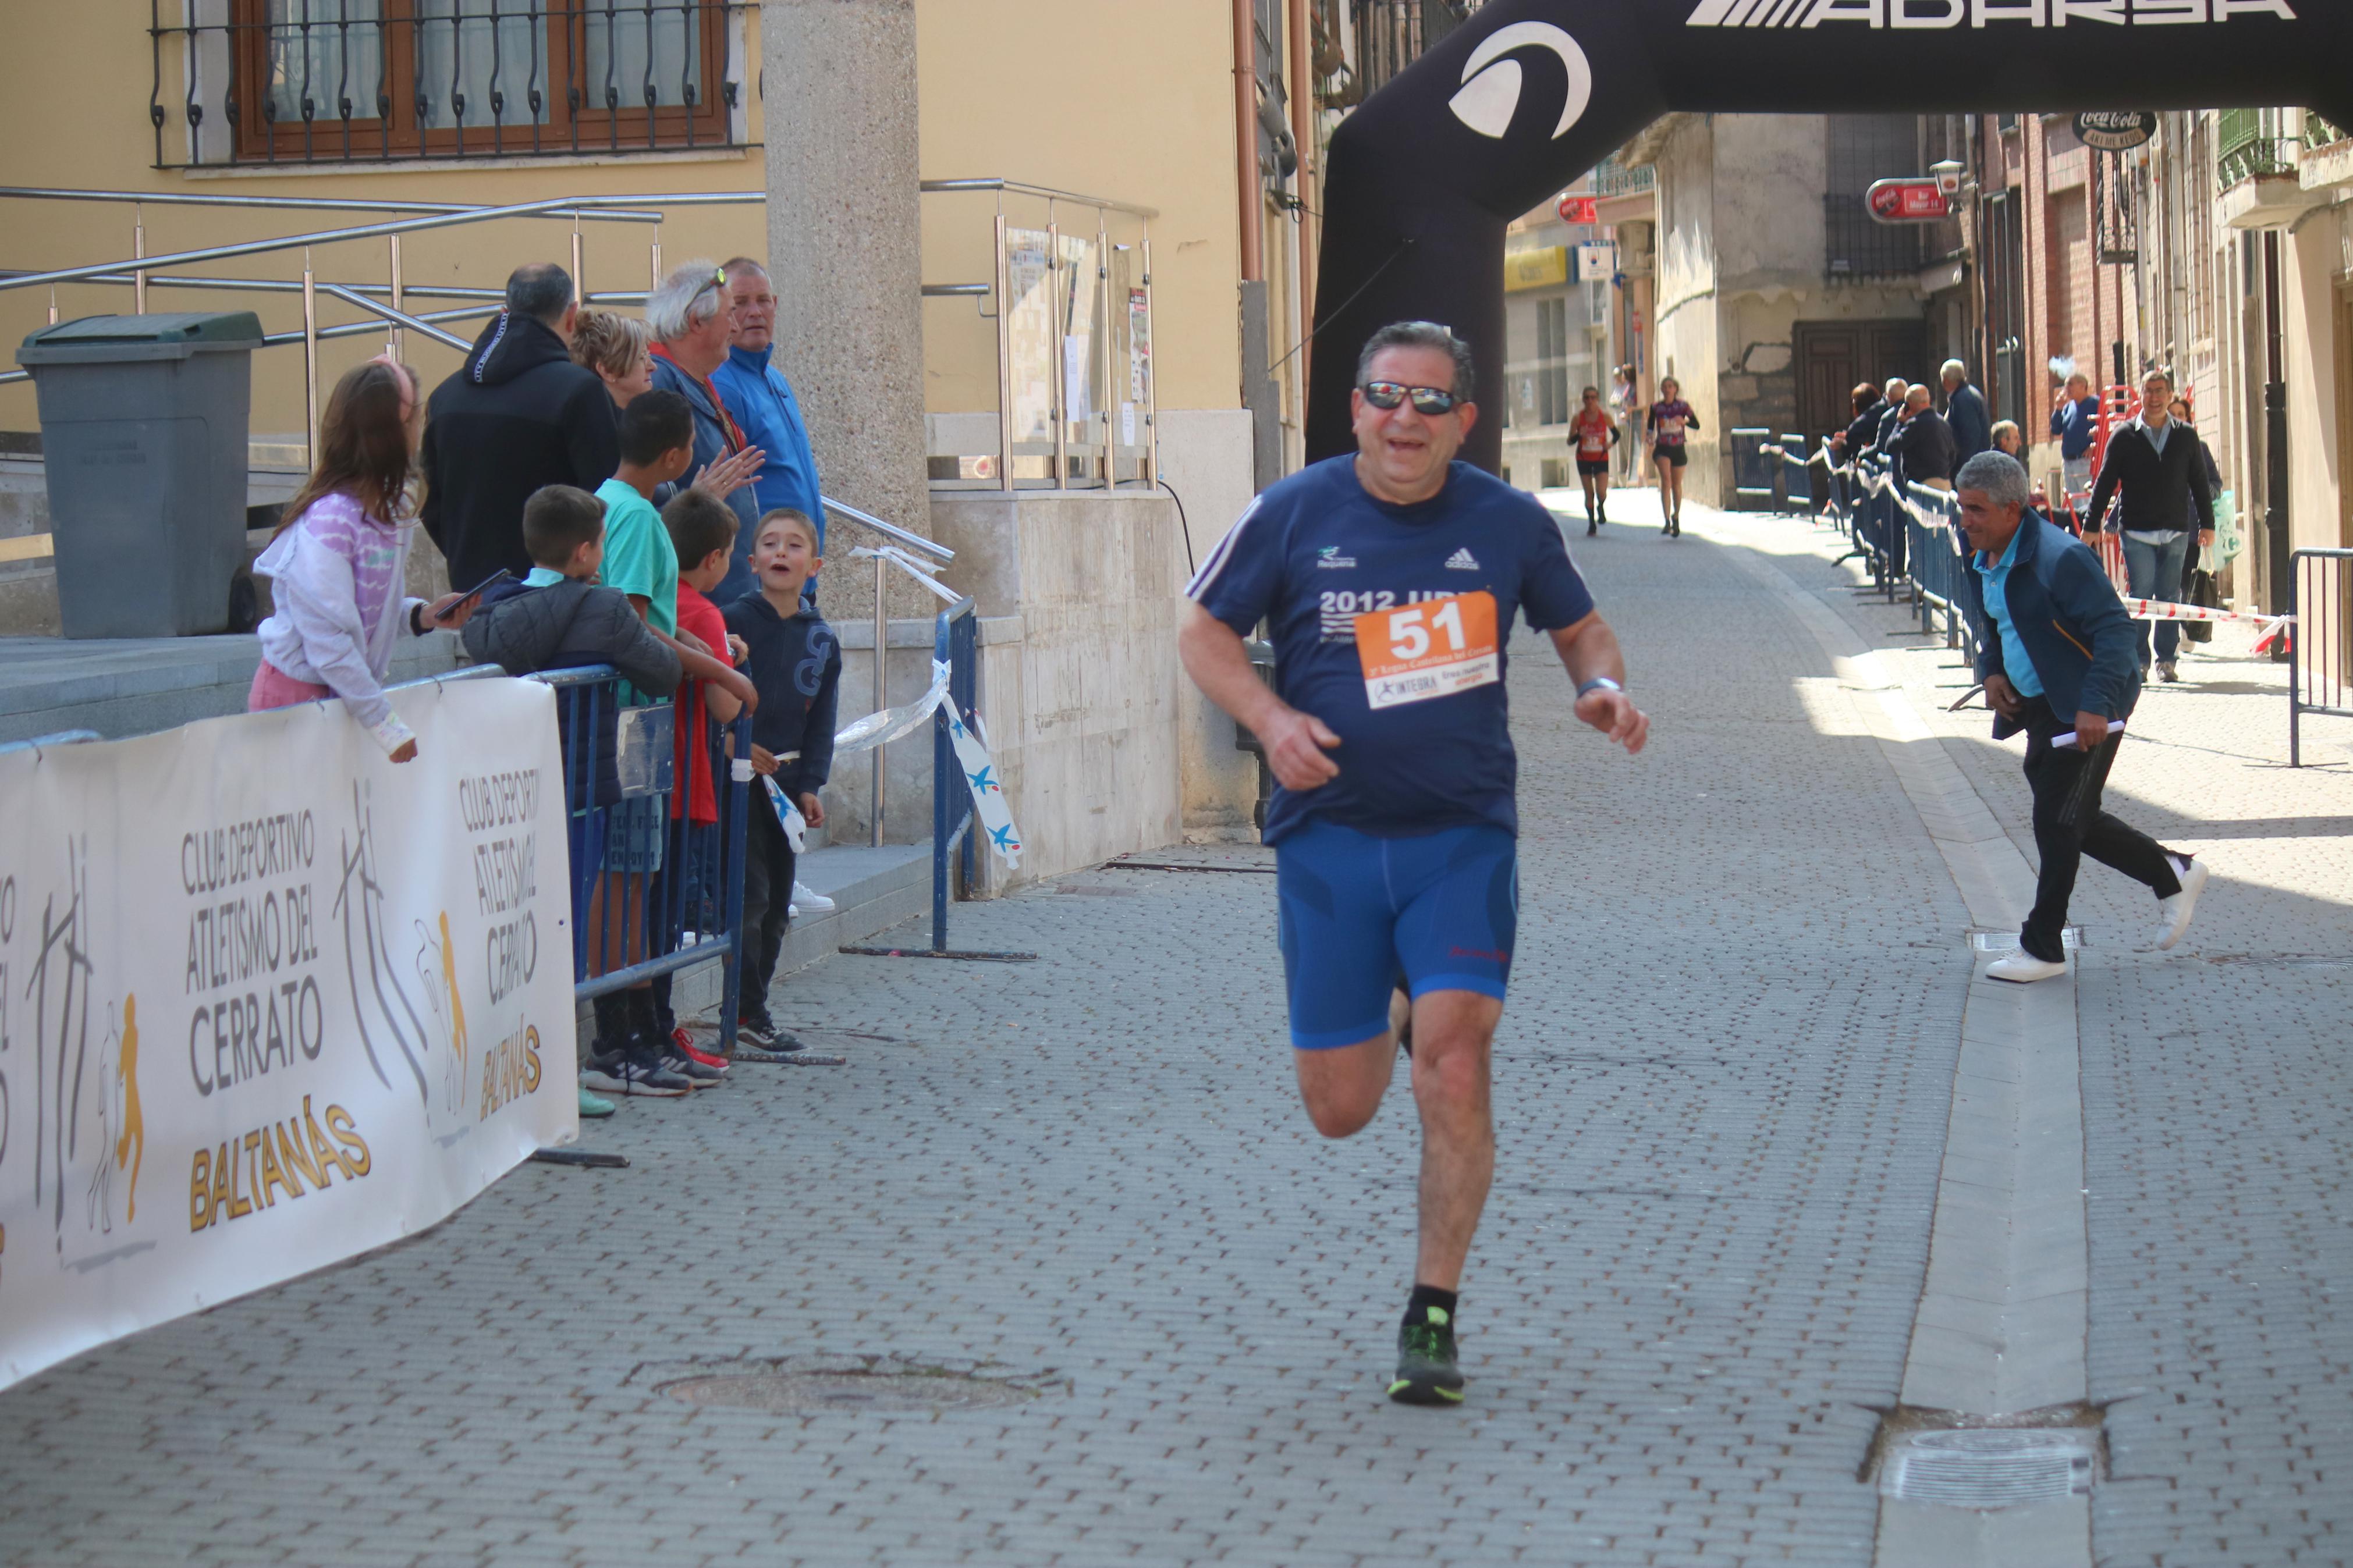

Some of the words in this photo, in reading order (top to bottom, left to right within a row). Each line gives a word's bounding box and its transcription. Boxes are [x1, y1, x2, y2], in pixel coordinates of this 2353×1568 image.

[1445, 561, 1479, 570] adidas
[1320, 591, 1396, 612] 2012
[1389, 601, 1465, 660] 51
[1396, 675, 1438, 695] INTEGRA
[460, 778, 494, 833] CLUB
[182, 830, 226, 895] CLUB
[229, 808, 314, 886] DEPORTIVO
[612, 851, 643, 866] ENOY
[186, 889, 281, 996] ATLETISMO
[286, 883, 318, 966] DEL
[190, 973, 323, 1097] CERRATO
[190, 1094, 371, 1233] BALTANÁS
